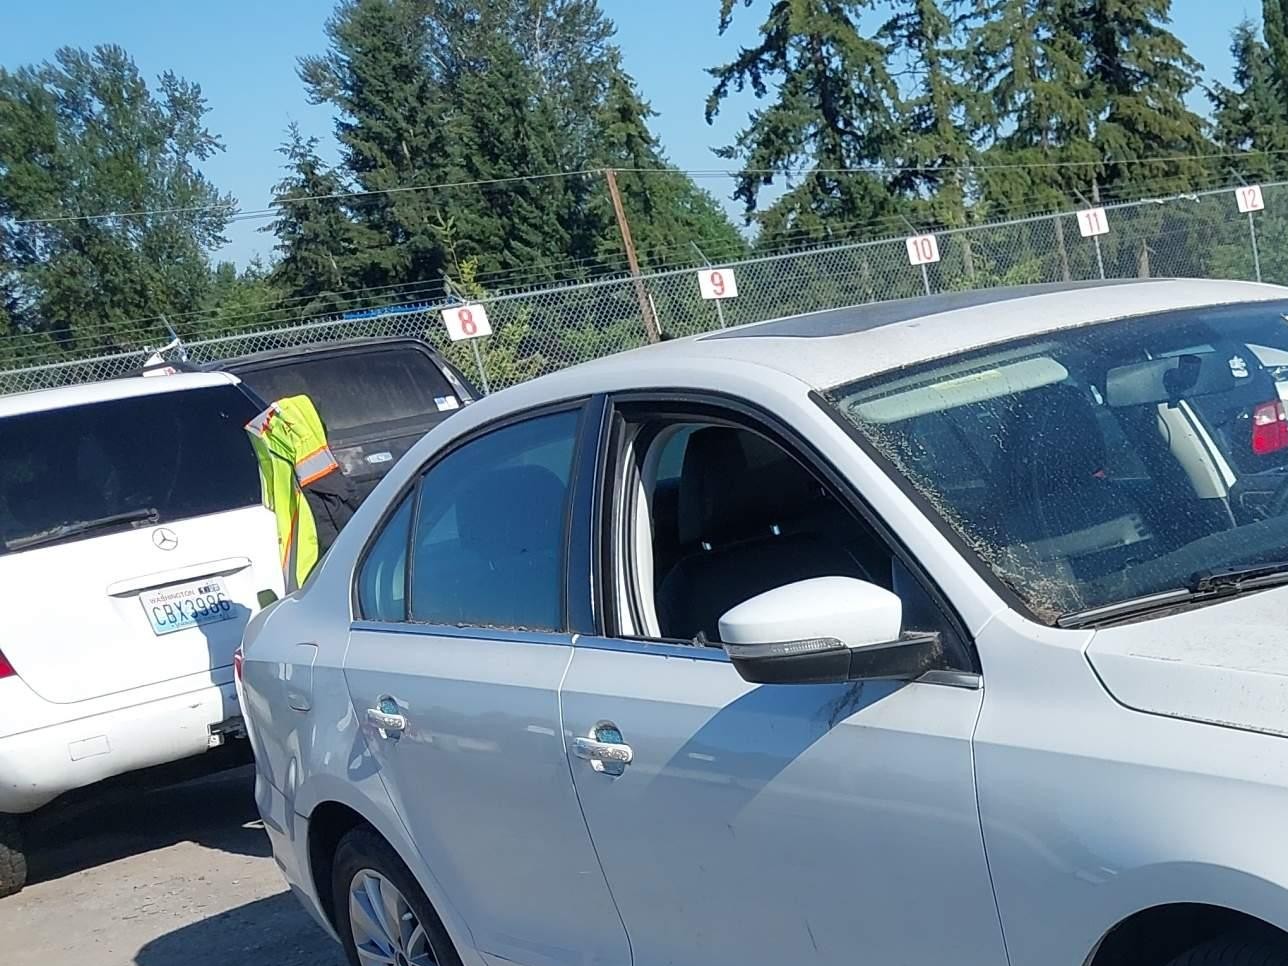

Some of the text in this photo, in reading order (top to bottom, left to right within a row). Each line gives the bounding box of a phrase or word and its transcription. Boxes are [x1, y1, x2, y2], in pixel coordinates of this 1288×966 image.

[1241, 188, 1257, 210] 12
[1084, 211, 1100, 233] 11
[911, 237, 934, 262] 10
[709, 270, 725, 297] 9
[457, 308, 478, 336] 8
[149, 589, 196, 604] WASHINGTON
[152, 592, 231, 626] CBX3986
